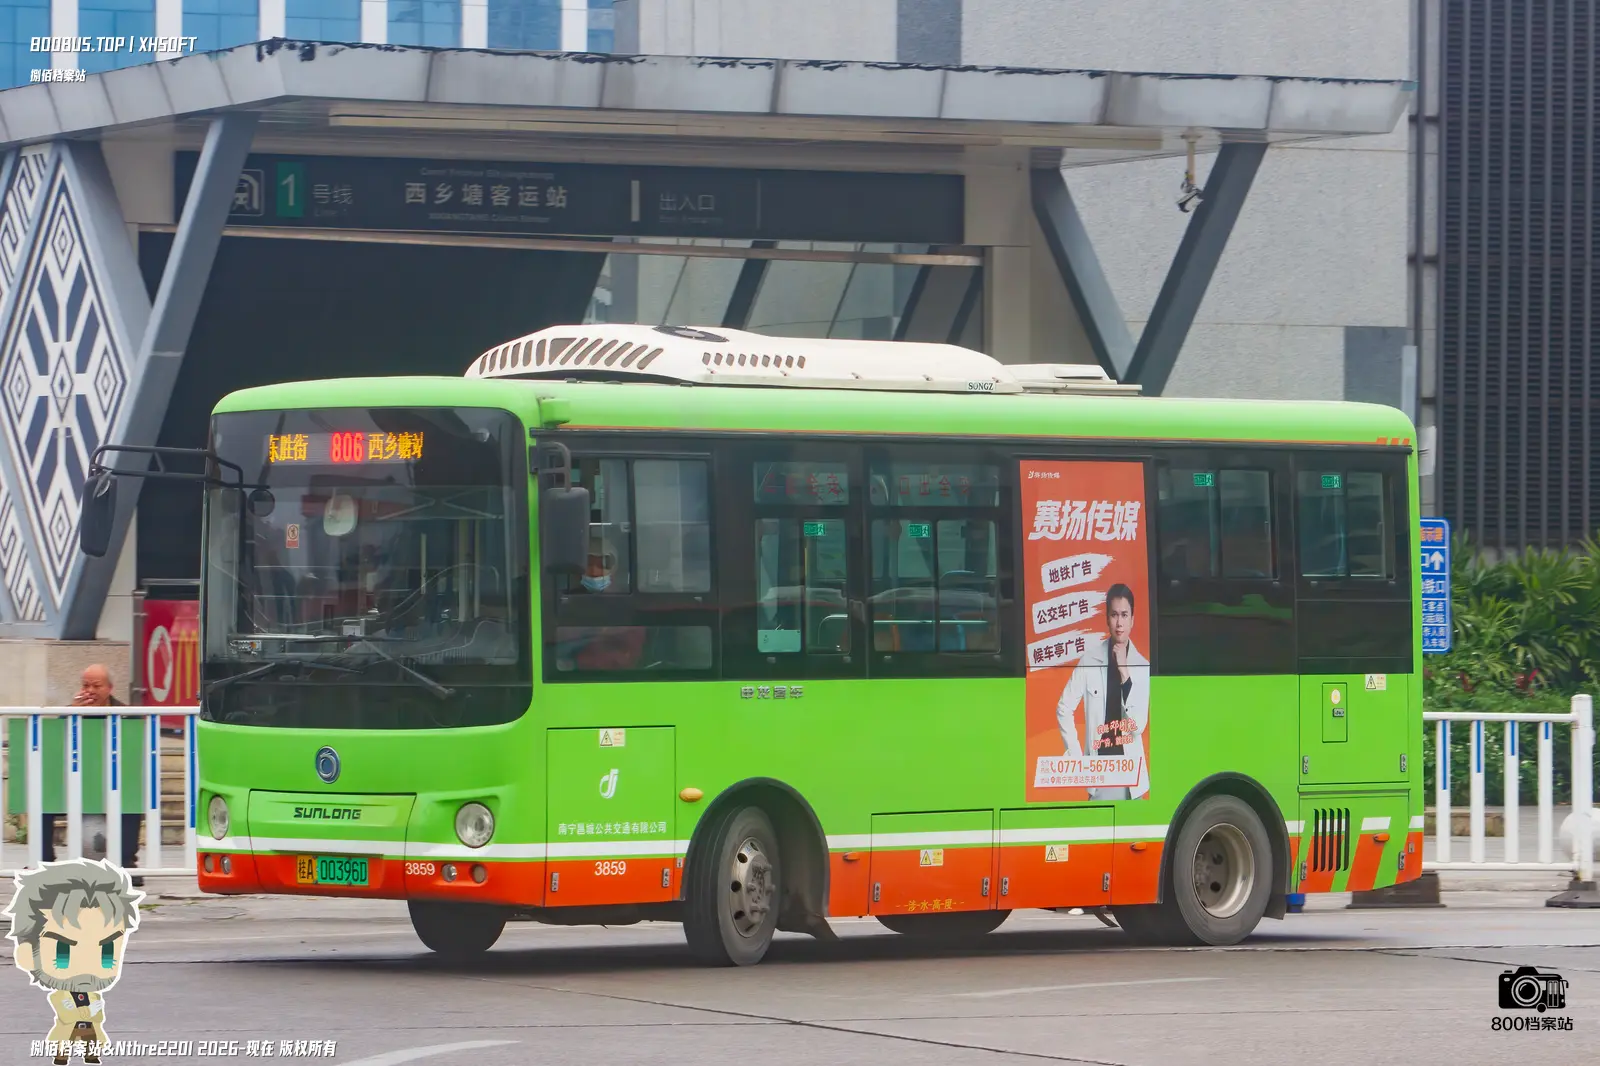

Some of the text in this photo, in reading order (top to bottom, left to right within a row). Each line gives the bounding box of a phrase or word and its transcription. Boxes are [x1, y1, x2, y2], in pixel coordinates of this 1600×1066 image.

[281, 173, 354, 206] 1 号线
[404, 181, 568, 210] 西乡塘客运站
[659, 190, 716, 211] 出入口
[968, 381, 994, 391] SONGZ
[331, 431, 364, 462] 806
[1028, 501, 1140, 542] 赛扬传媒
[1048, 559, 1092, 584] 地铁广告
[1036, 598, 1089, 625] 公交车广告
[1032, 637, 1085, 664] 候车亭广告
[1057, 758, 1134, 774] 0771-5675180
[294, 806, 362, 821] SUNLONG
[320, 859, 368, 883] 00396D
[405, 861, 436, 876] 3859
[594, 860, 627, 877] 3859
